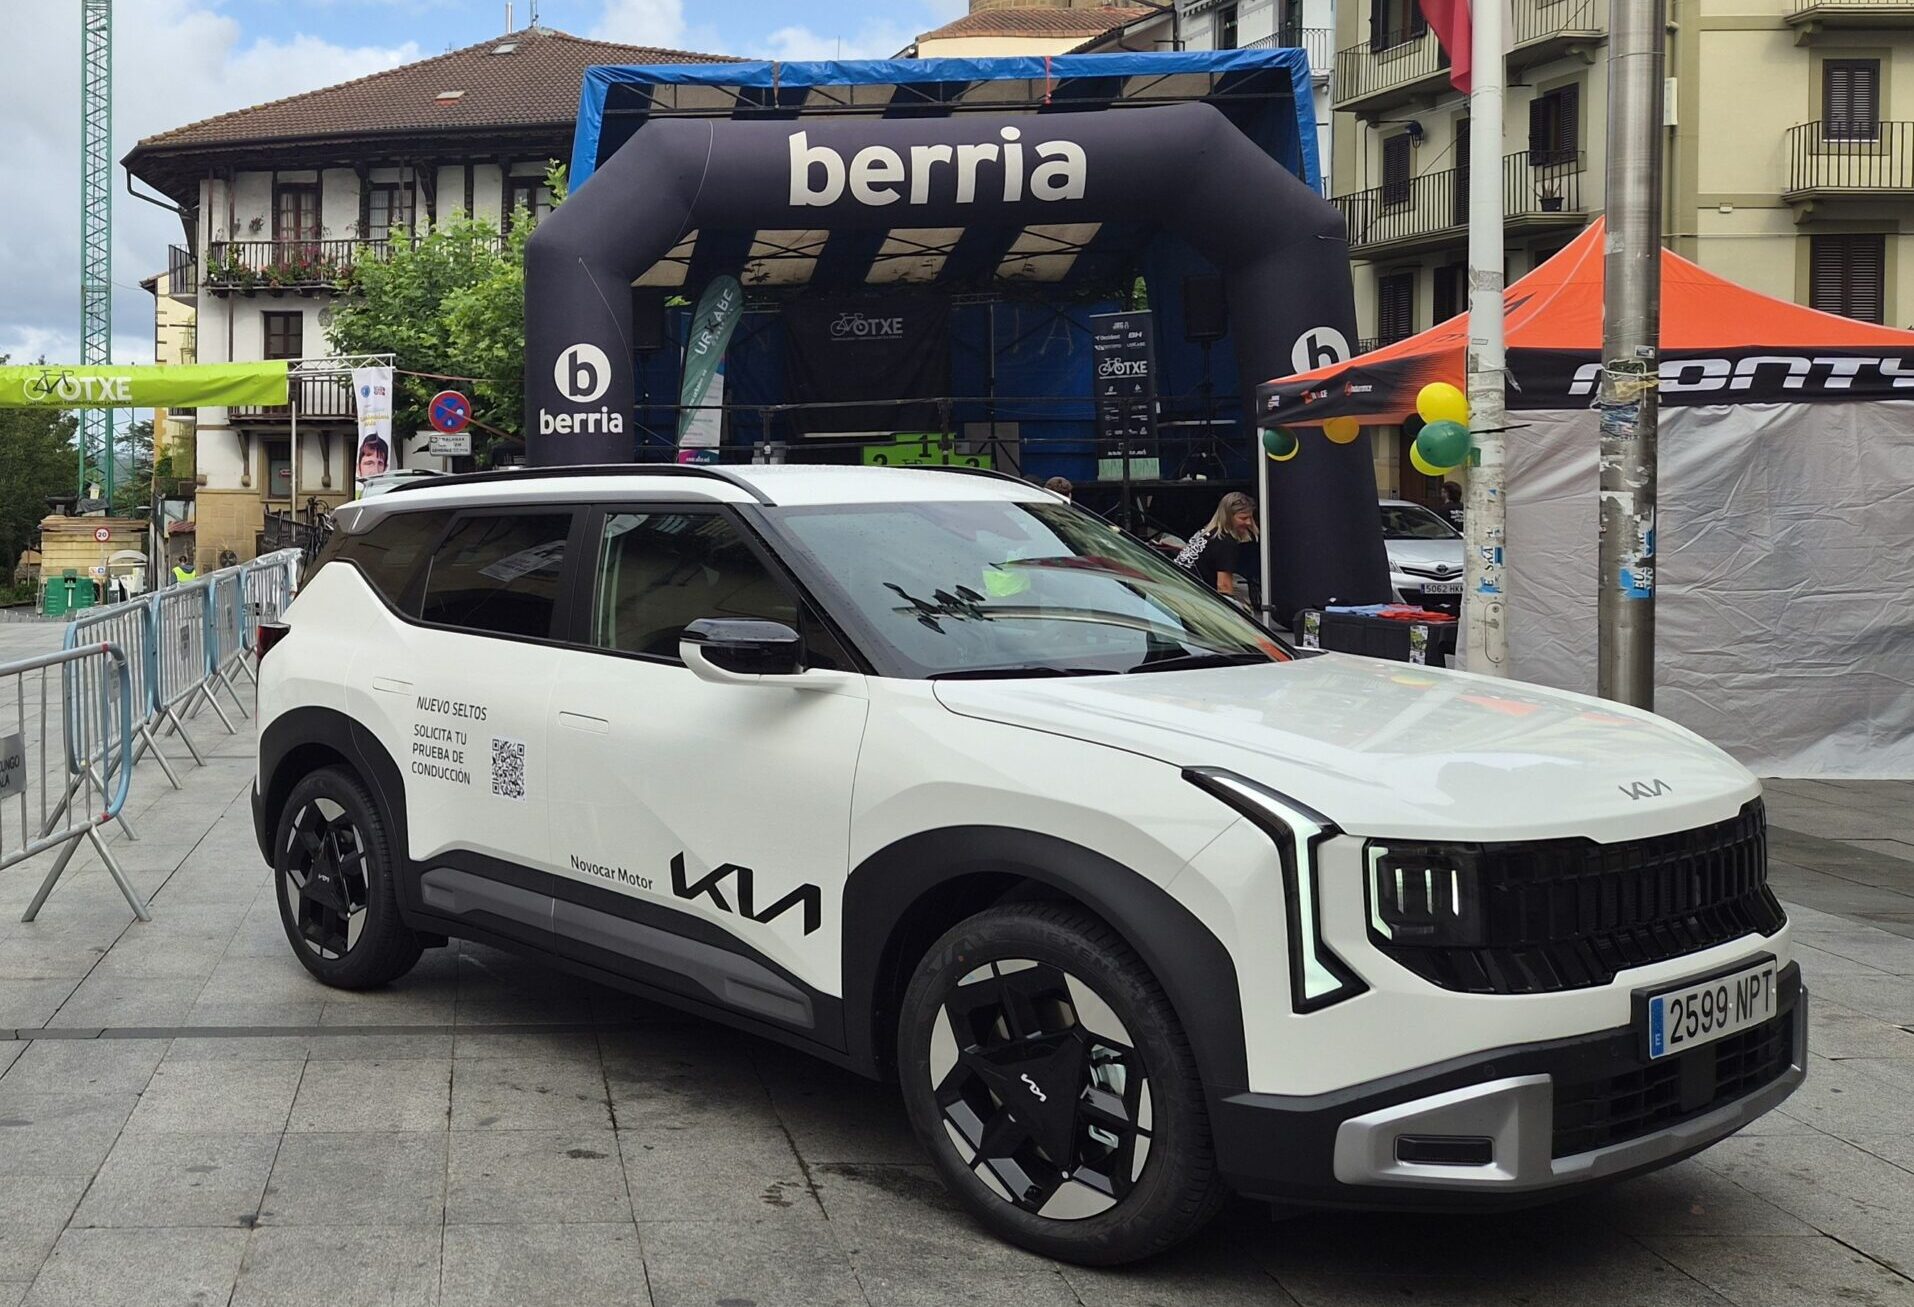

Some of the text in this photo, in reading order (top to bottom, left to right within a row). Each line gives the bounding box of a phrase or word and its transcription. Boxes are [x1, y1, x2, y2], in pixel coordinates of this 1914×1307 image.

[789, 126, 1087, 206] berria
[568, 350, 598, 397] b
[57, 376, 132, 400] OTXE
[540, 406, 623, 435] berria
[97, 531, 107, 539] 20
[1426, 585, 1447, 593] 5062
[416, 696, 488, 721] NUEVO SELTOS
[414, 724, 467, 746] SOLICITA TU
[412, 742, 464, 764] PRUEBA DE
[411, 761, 471, 785] CONDUCCIÓN
[570, 854, 653, 891] Novocar Motor
[670, 851, 821, 936] KIA
[1669, 968, 1773, 1045] 2599 NPT
[1655, 1033, 1662, 1046] E
